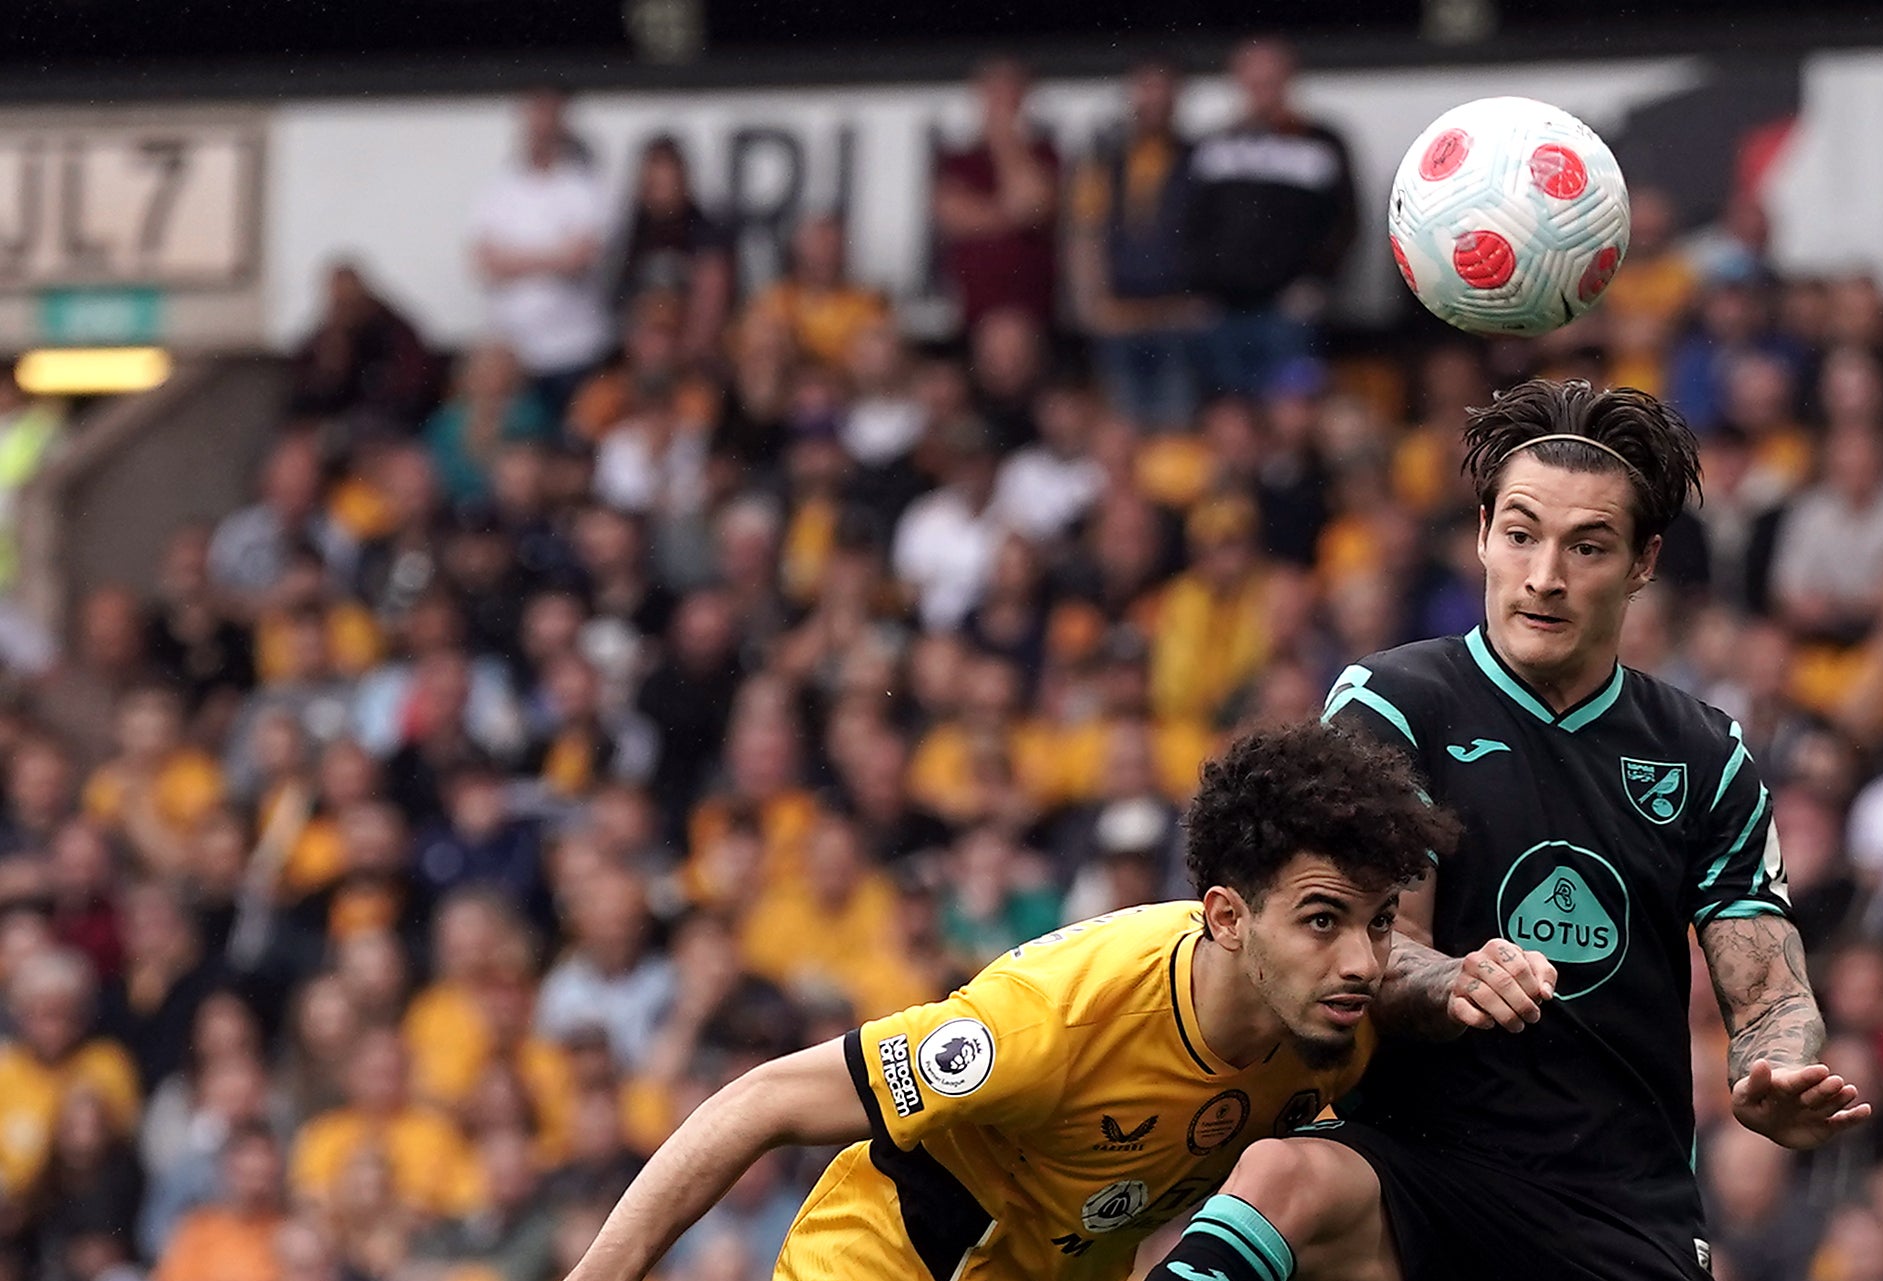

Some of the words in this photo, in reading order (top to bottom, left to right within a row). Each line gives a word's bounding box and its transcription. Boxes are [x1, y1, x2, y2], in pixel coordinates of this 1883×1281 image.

[1517, 916, 1609, 949] LOTUS
[889, 1035, 909, 1061] No
[883, 1063, 911, 1118] racism
[897, 1061, 920, 1106] room
